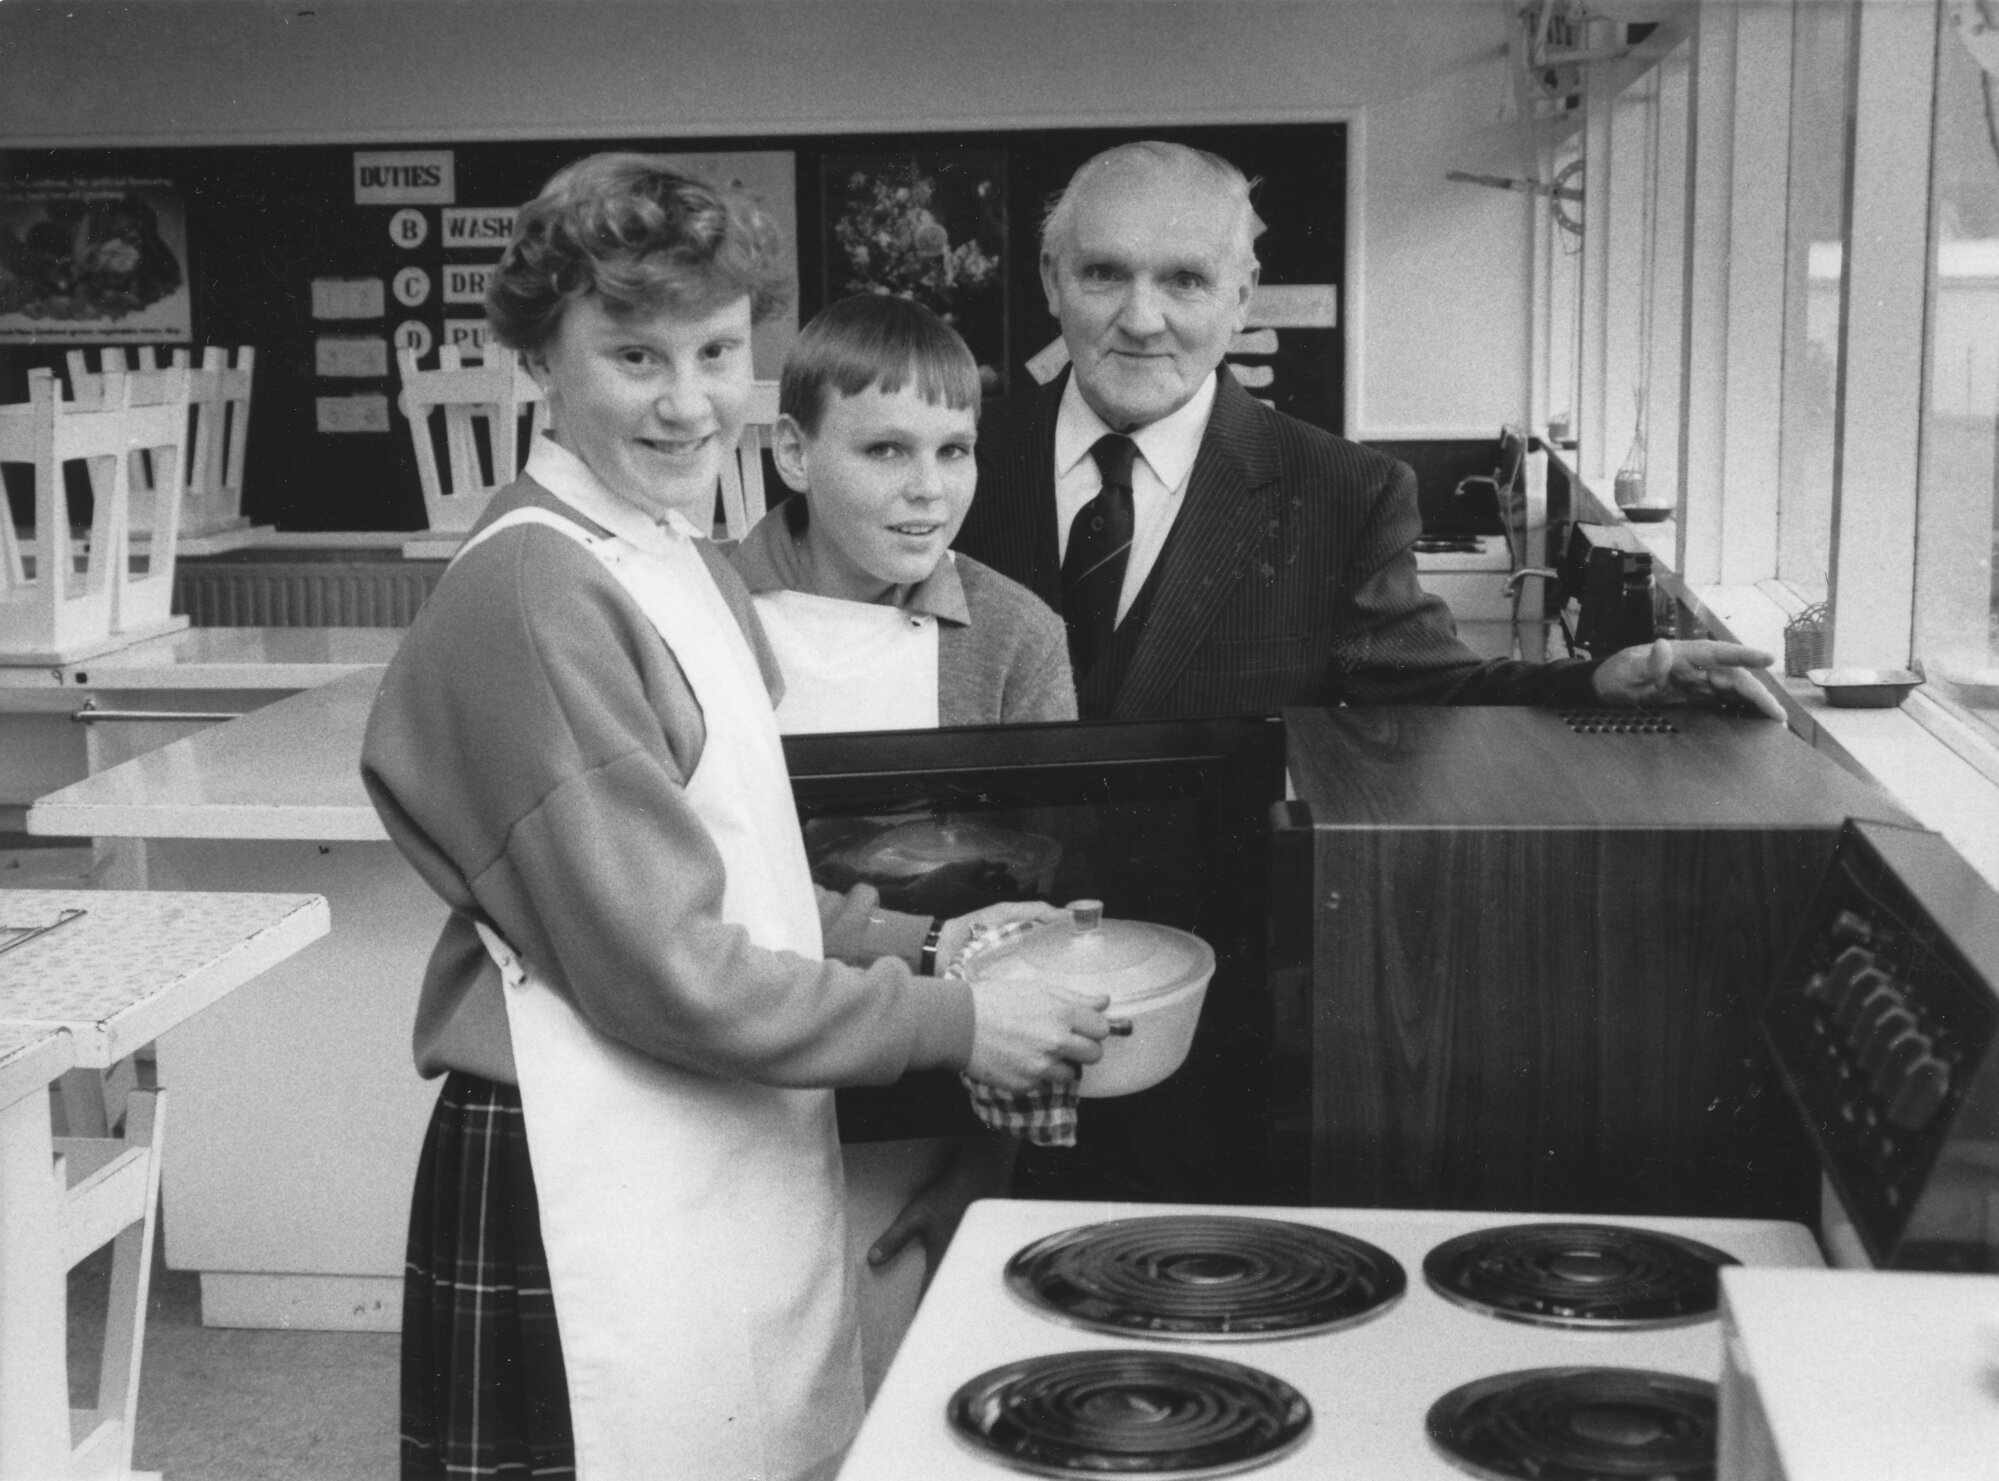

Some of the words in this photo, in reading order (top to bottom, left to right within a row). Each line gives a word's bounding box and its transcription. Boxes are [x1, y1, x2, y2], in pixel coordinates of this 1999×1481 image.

[360, 165, 441, 187] DUTIES
[401, 218, 418, 240] B
[449, 217, 513, 238] WASH
[404, 276, 420, 298] C
[451, 271, 489, 293] DR
[407, 329, 422, 349] D
[453, 327, 487, 348] PU
